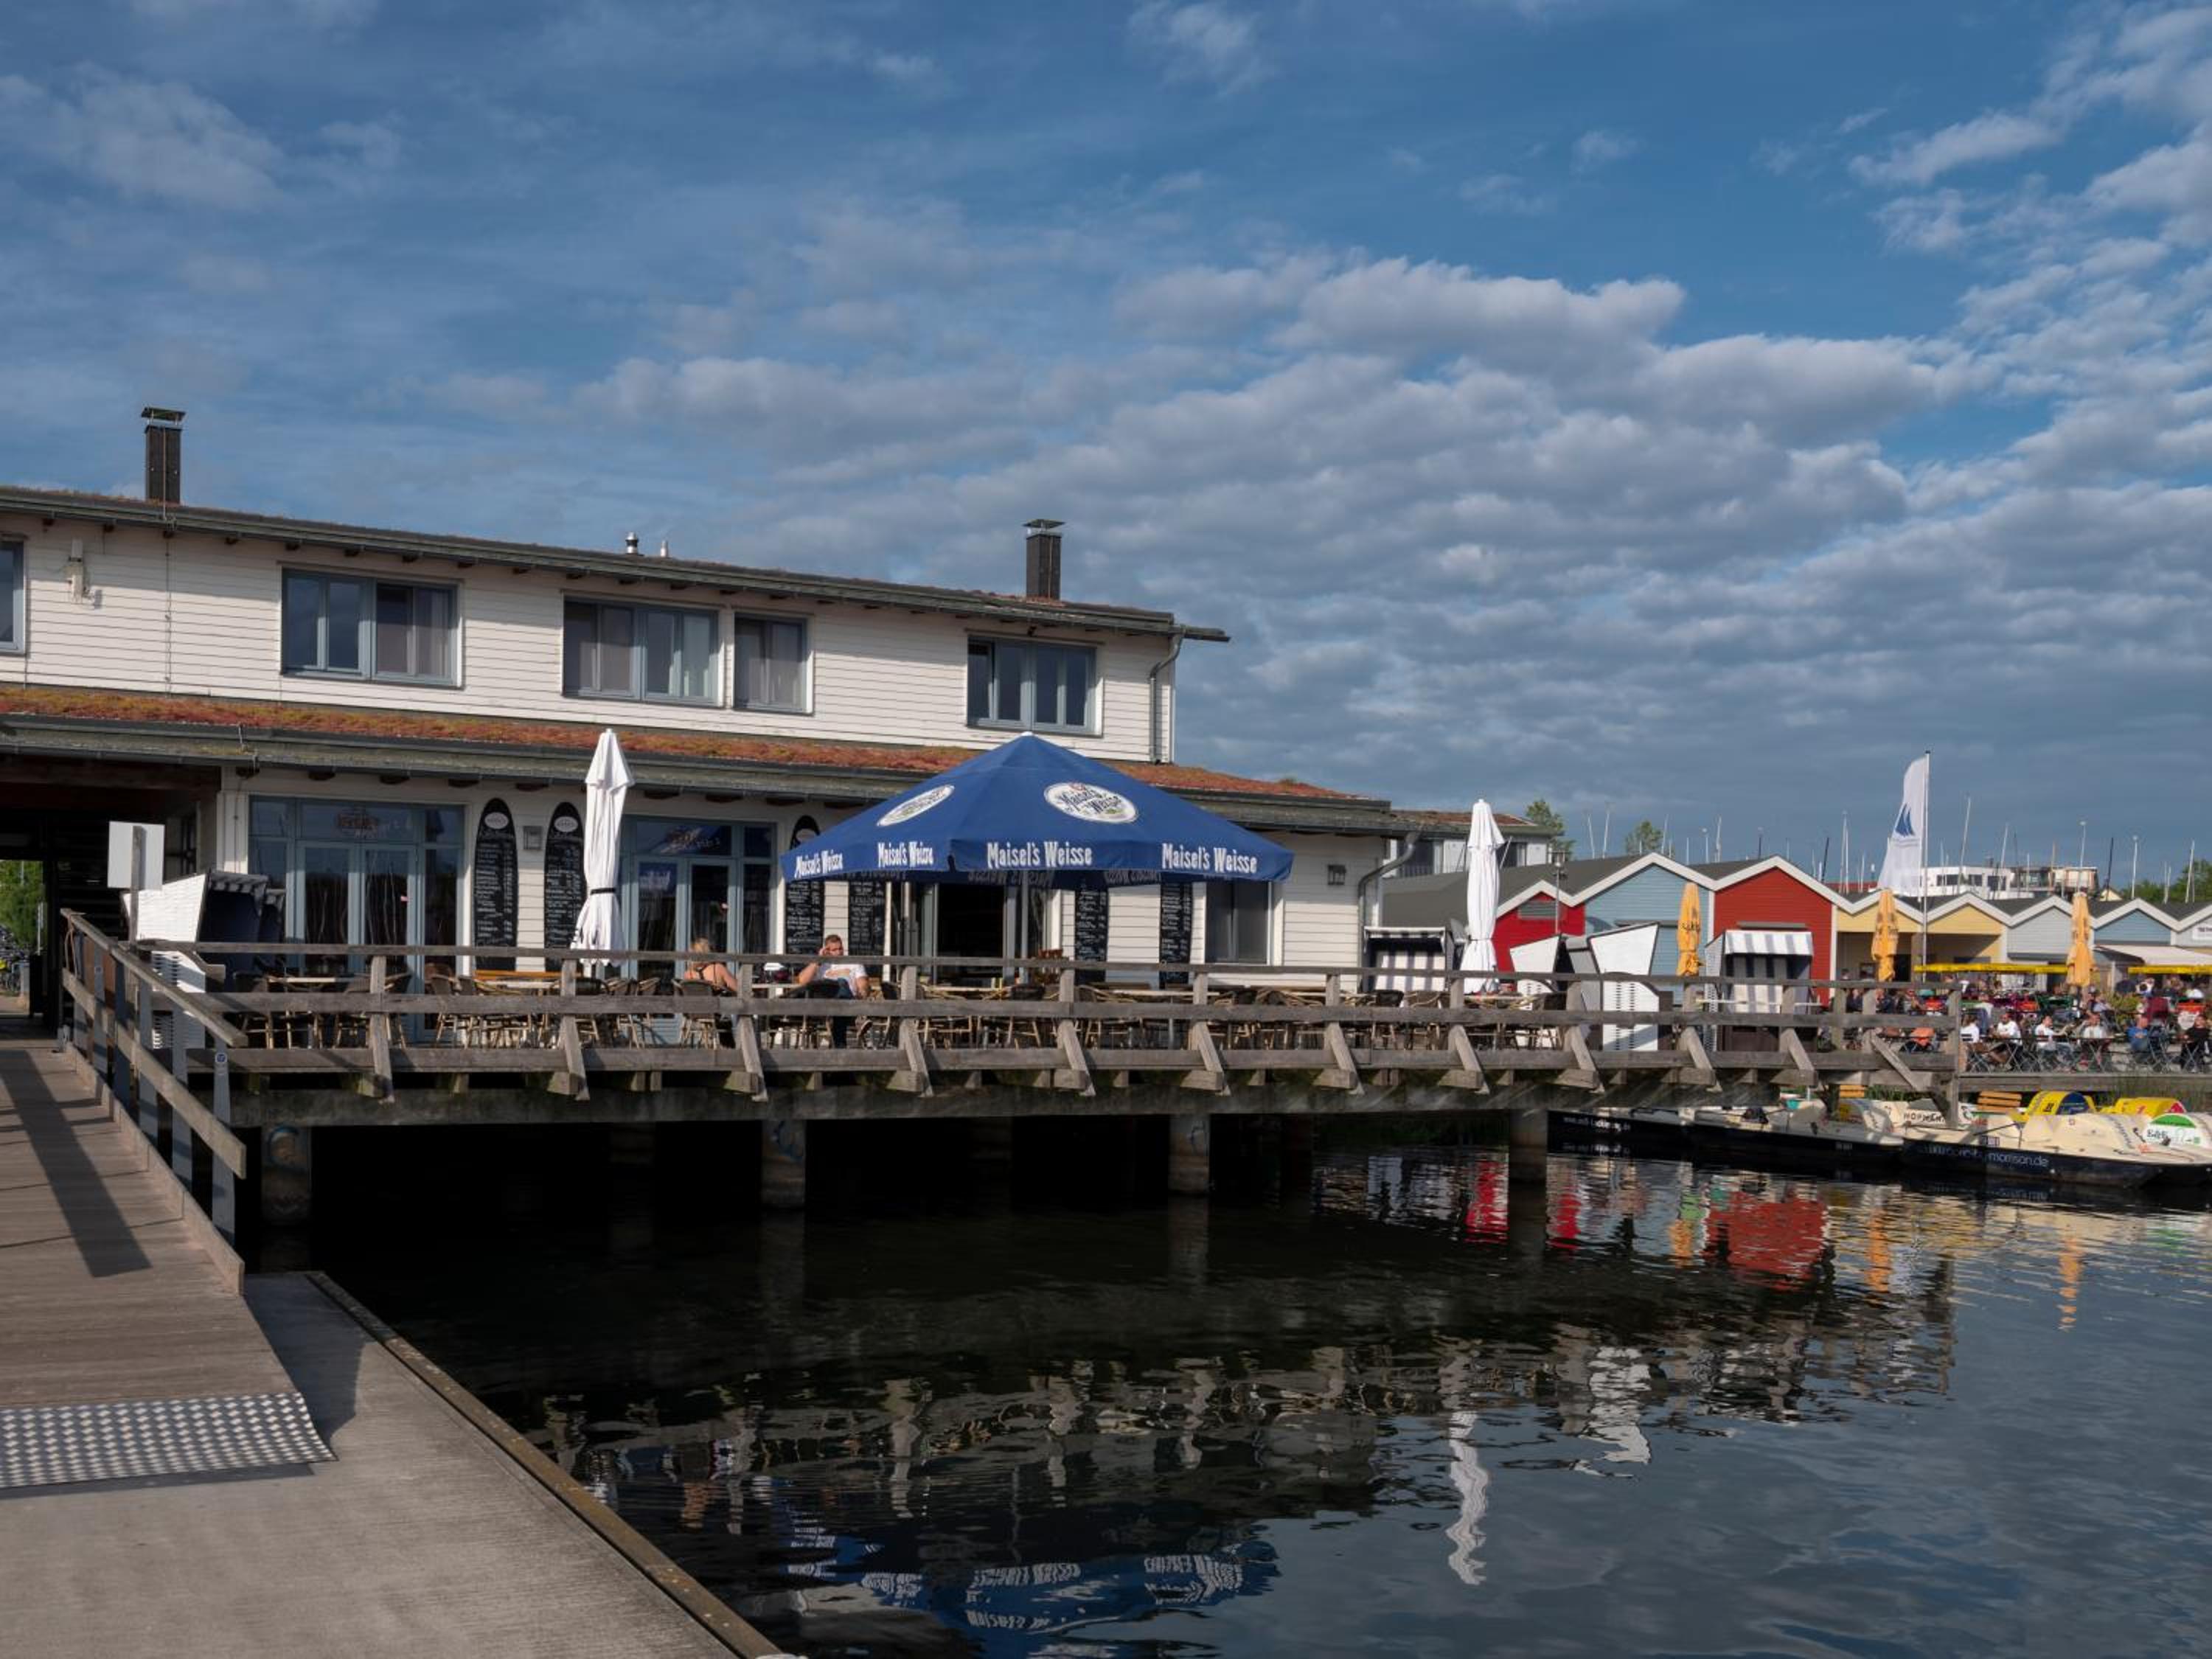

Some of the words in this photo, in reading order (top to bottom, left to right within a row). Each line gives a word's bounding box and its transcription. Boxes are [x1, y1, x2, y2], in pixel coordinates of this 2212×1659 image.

[794, 853, 821, 879] Maisel's
[821, 849, 844, 874] Weisse
[877, 841, 907, 868] Maisel's
[908, 841, 933, 868] Weisse
[987, 841, 1040, 869] Maisel's
[1043, 841, 1093, 868] Weisse
[1161, 843, 1210, 869] Maisel's
[1213, 846, 1257, 874] Weisse
